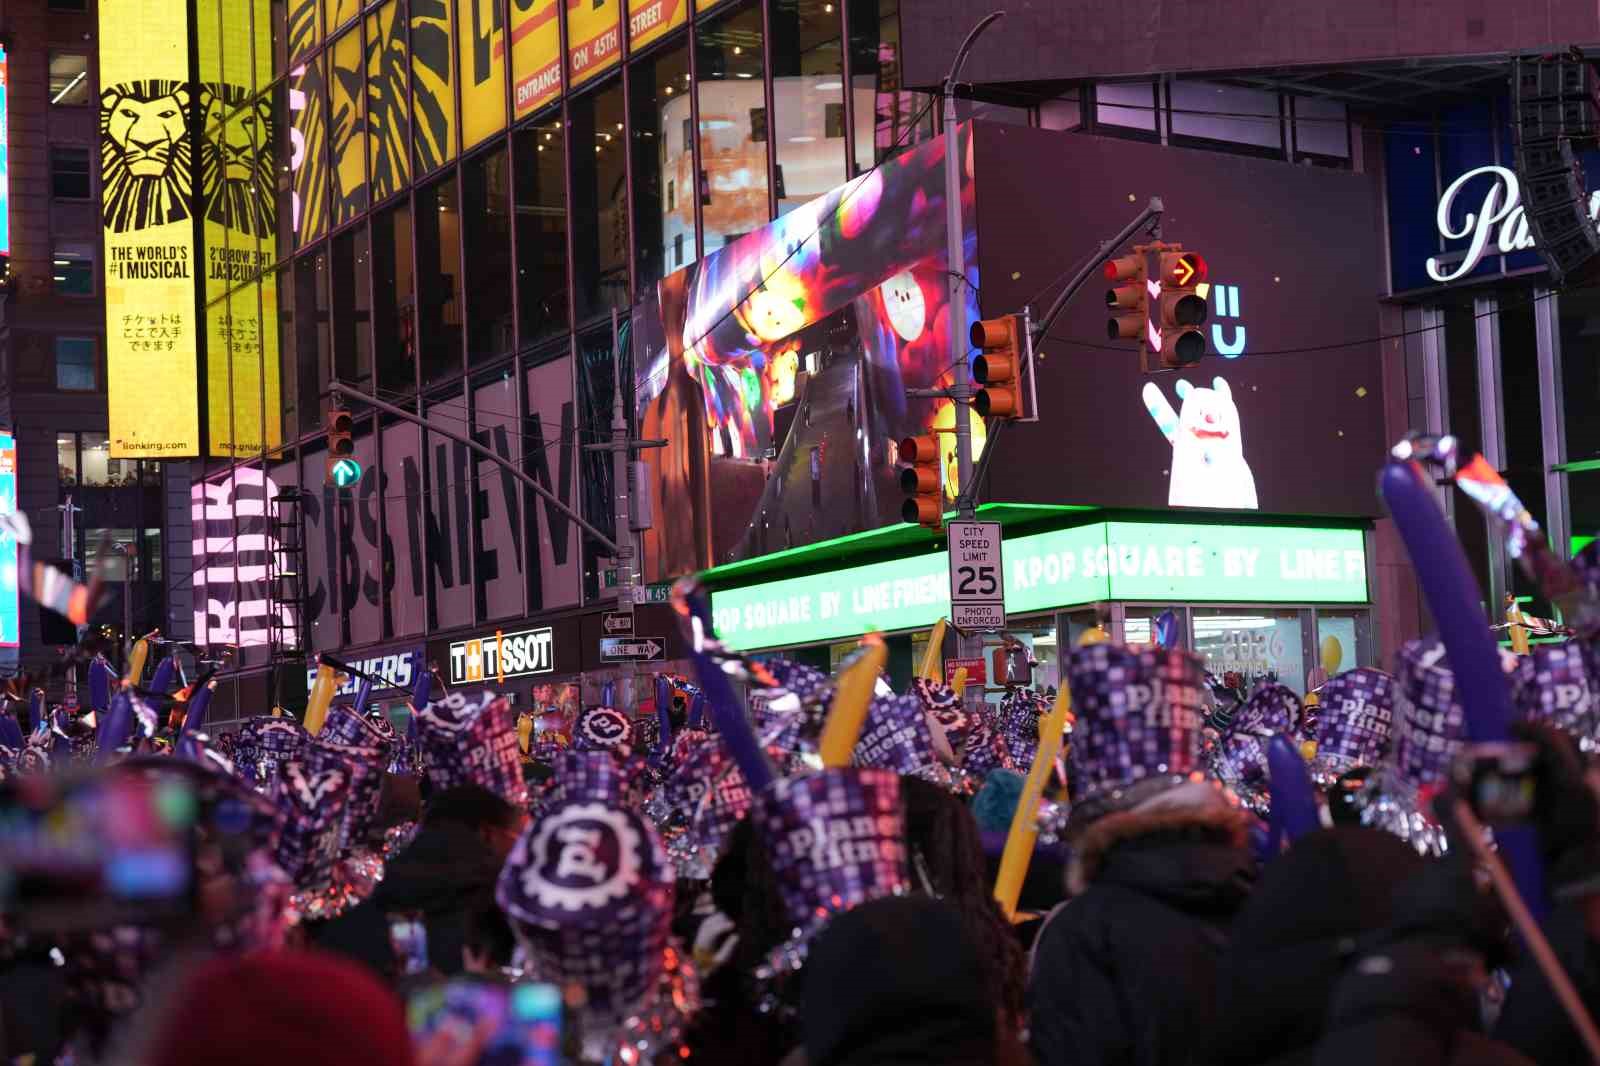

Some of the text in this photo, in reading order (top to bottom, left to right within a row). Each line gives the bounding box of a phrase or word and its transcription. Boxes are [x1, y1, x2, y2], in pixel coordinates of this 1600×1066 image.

[517, 4, 663, 104] ENTRANCE ON 45TH STREET
[111, 245, 188, 261] THE WORLD'S
[127, 261, 191, 279] MUSICAL
[123, 327, 182, 339] ここで入手
[128, 341, 177, 352] できます
[122, 441, 188, 450] lionking.com
[963, 527, 985, 537] CITY
[959, 539, 990, 549] SPEED
[963, 551, 988, 562] LIMIT
[1013, 551, 1076, 590] KPOP
[1082, 545, 1205, 577] SQUARE
[1223, 546, 1261, 577] BY
[957, 566, 997, 595] 25
[744, 595, 812, 630] SQUARE
[819, 592, 841, 619] BY
[964, 607, 992, 616] PHOTO
[957, 616, 1001, 626] ENFORCED
